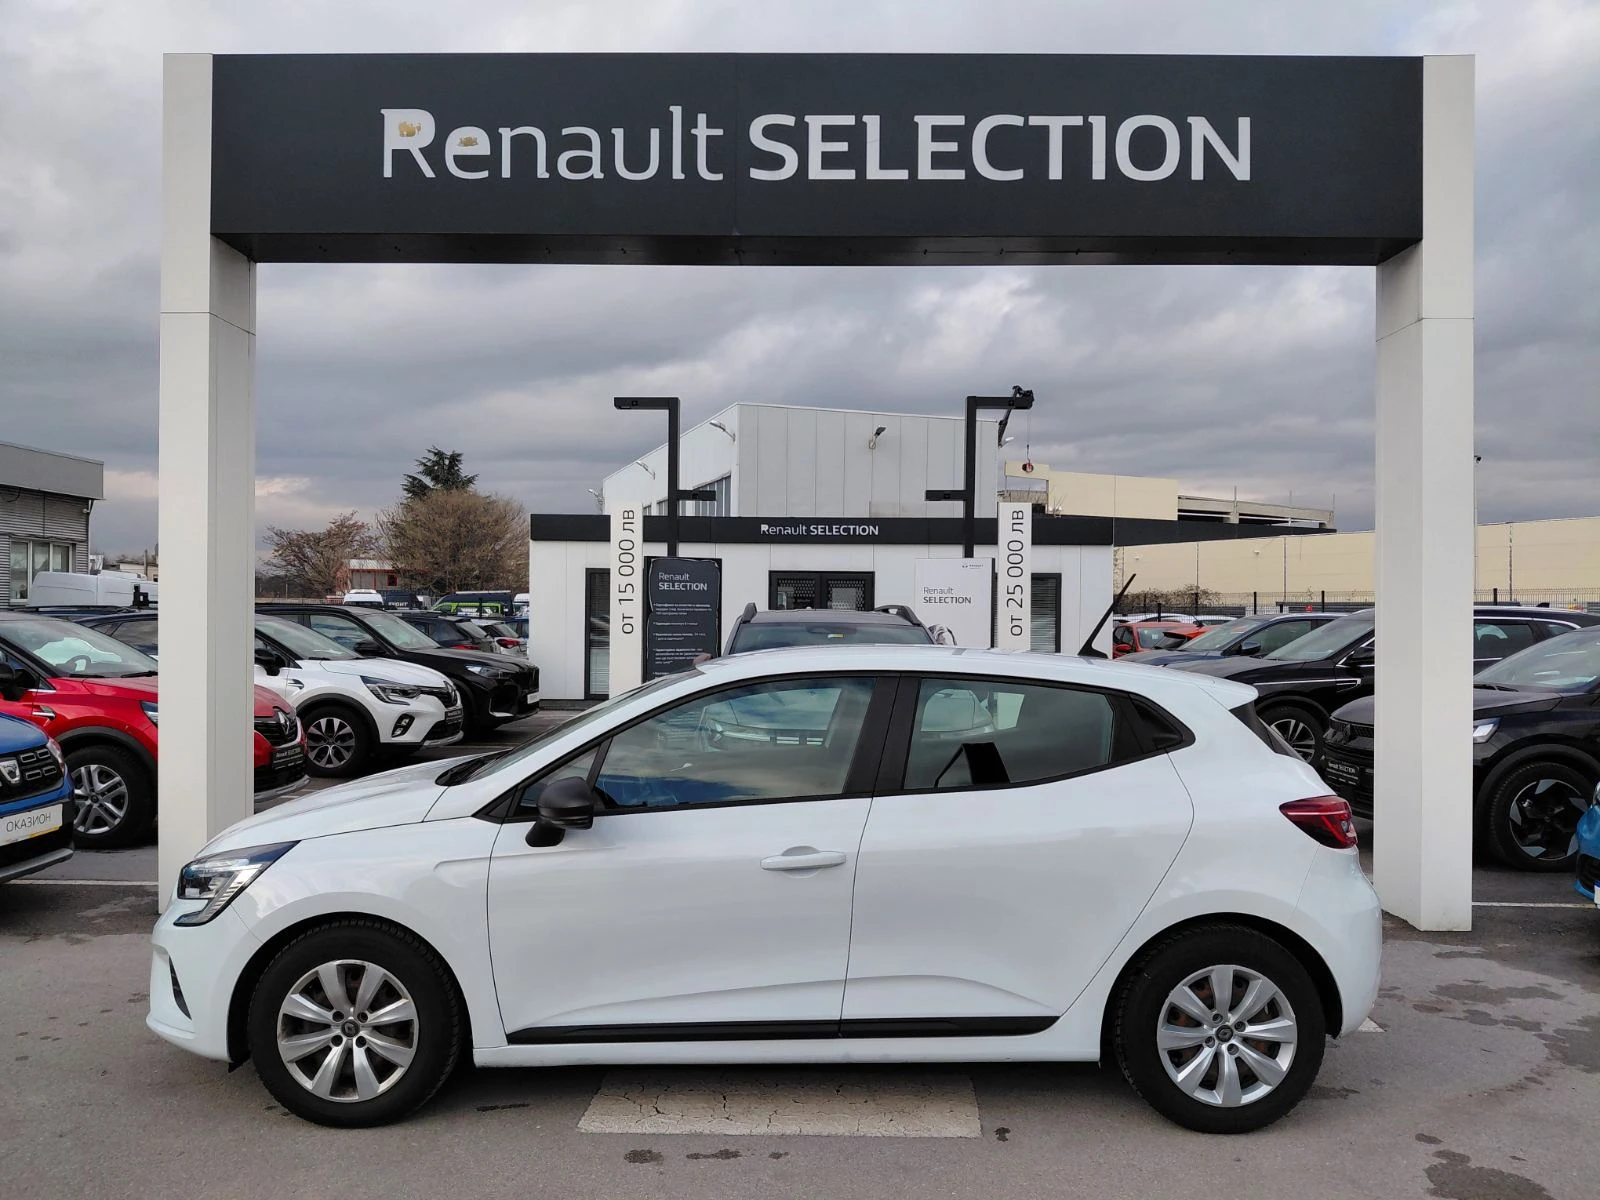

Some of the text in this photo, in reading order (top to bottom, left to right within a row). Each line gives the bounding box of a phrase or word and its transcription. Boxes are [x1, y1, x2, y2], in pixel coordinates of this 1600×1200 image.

[381, 105, 1252, 182] Renault SELECTION
[760, 523, 879, 536] Renault SELECTION
[618, 539, 635, 577] 000
[1006, 539, 1024, 578] 000
[658, 572, 690, 581] Renault
[658, 582, 708, 591] SELECTION
[618, 583, 635, 606] 15
[923, 586, 955, 595] Renault
[923, 596, 972, 604] SELECTION
[1006, 584, 1024, 609] 25
[6, 812, 51, 832] ОКАЗИОН
